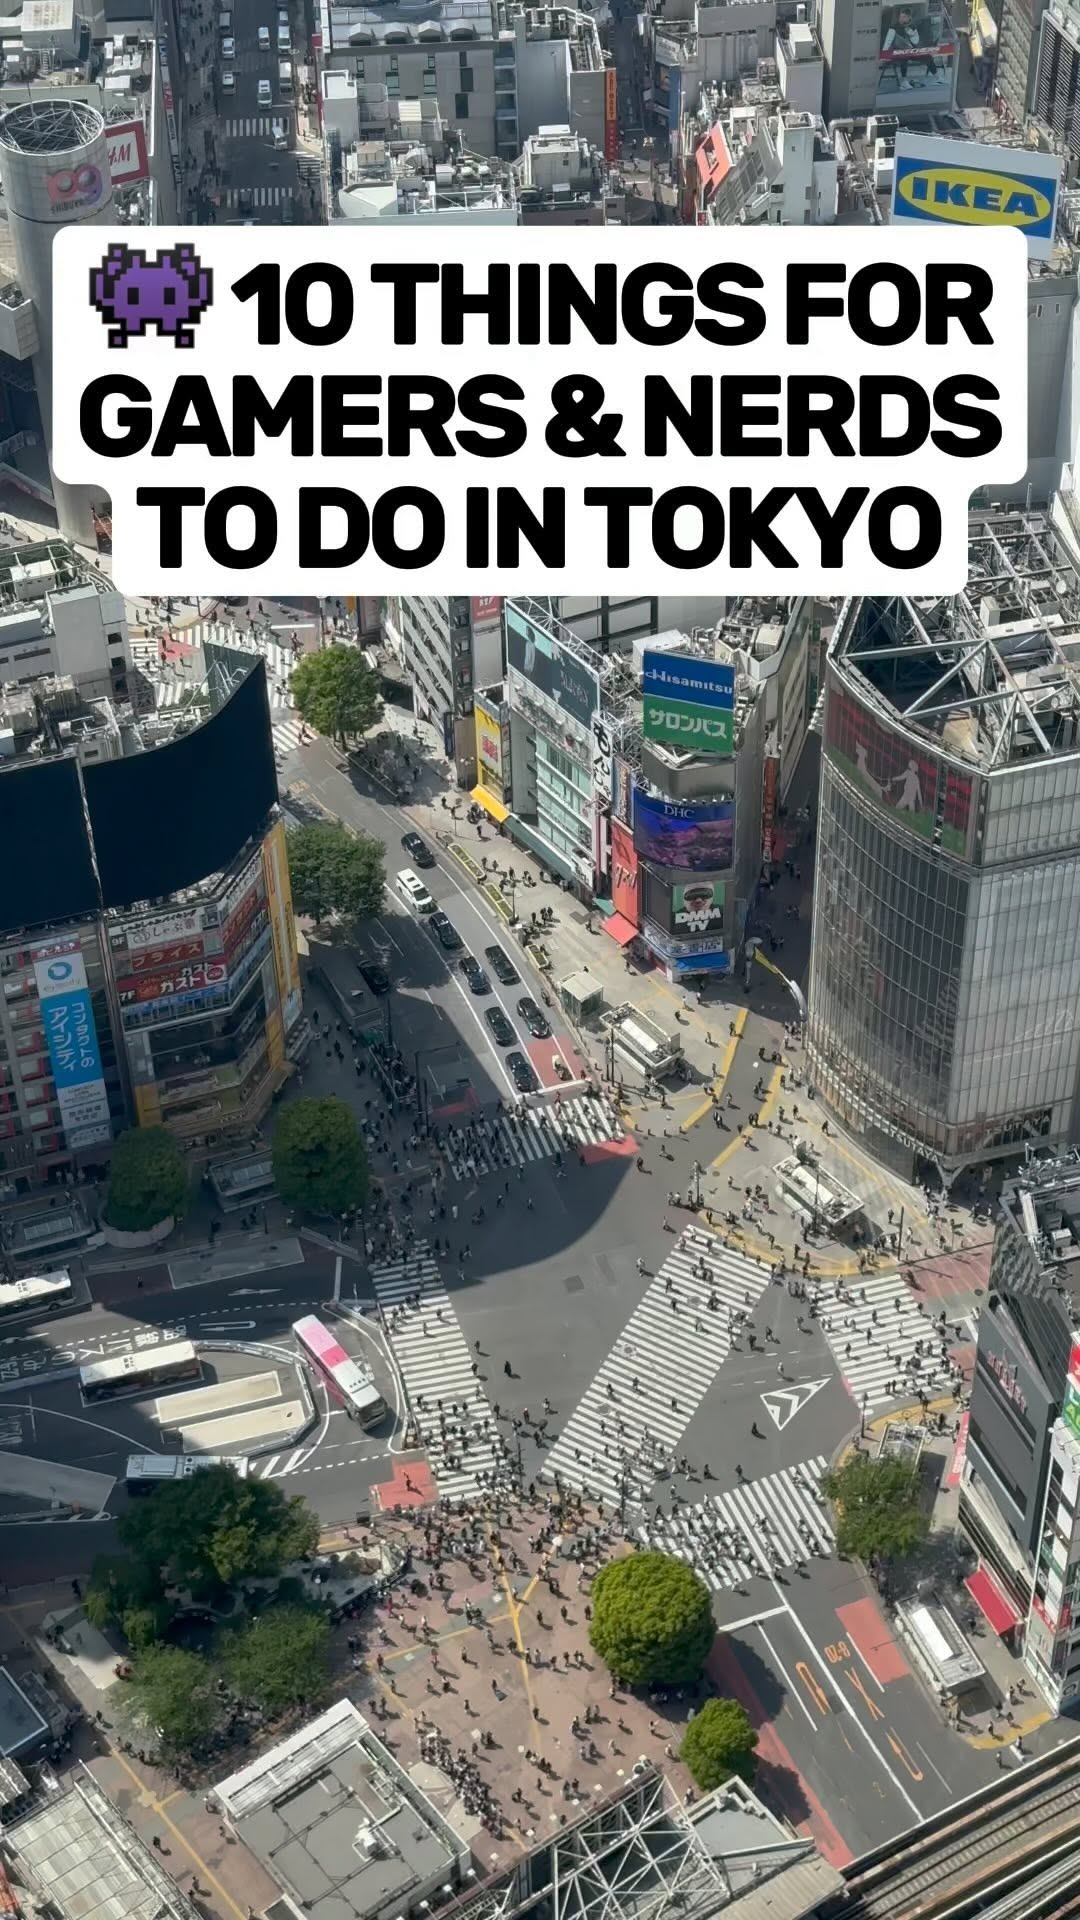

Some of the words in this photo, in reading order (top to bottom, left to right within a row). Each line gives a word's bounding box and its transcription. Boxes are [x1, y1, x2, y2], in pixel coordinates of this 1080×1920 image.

[911, 176, 1040, 218] IKEA
[645, 668, 733, 694] Hisamitsu
[649, 708, 727, 739] サロンパス
[663, 804, 695, 819] DHC
[675, 907, 721, 924] DMM
[687, 919, 709, 932] TV
[111, 936, 127, 947] 9F
[119, 990, 136, 1000] 7F
[159, 976, 201, 995] ガスト
[48, 1005, 77, 1072] アイシティ
[71, 1001, 95, 1068] コンタクトの
